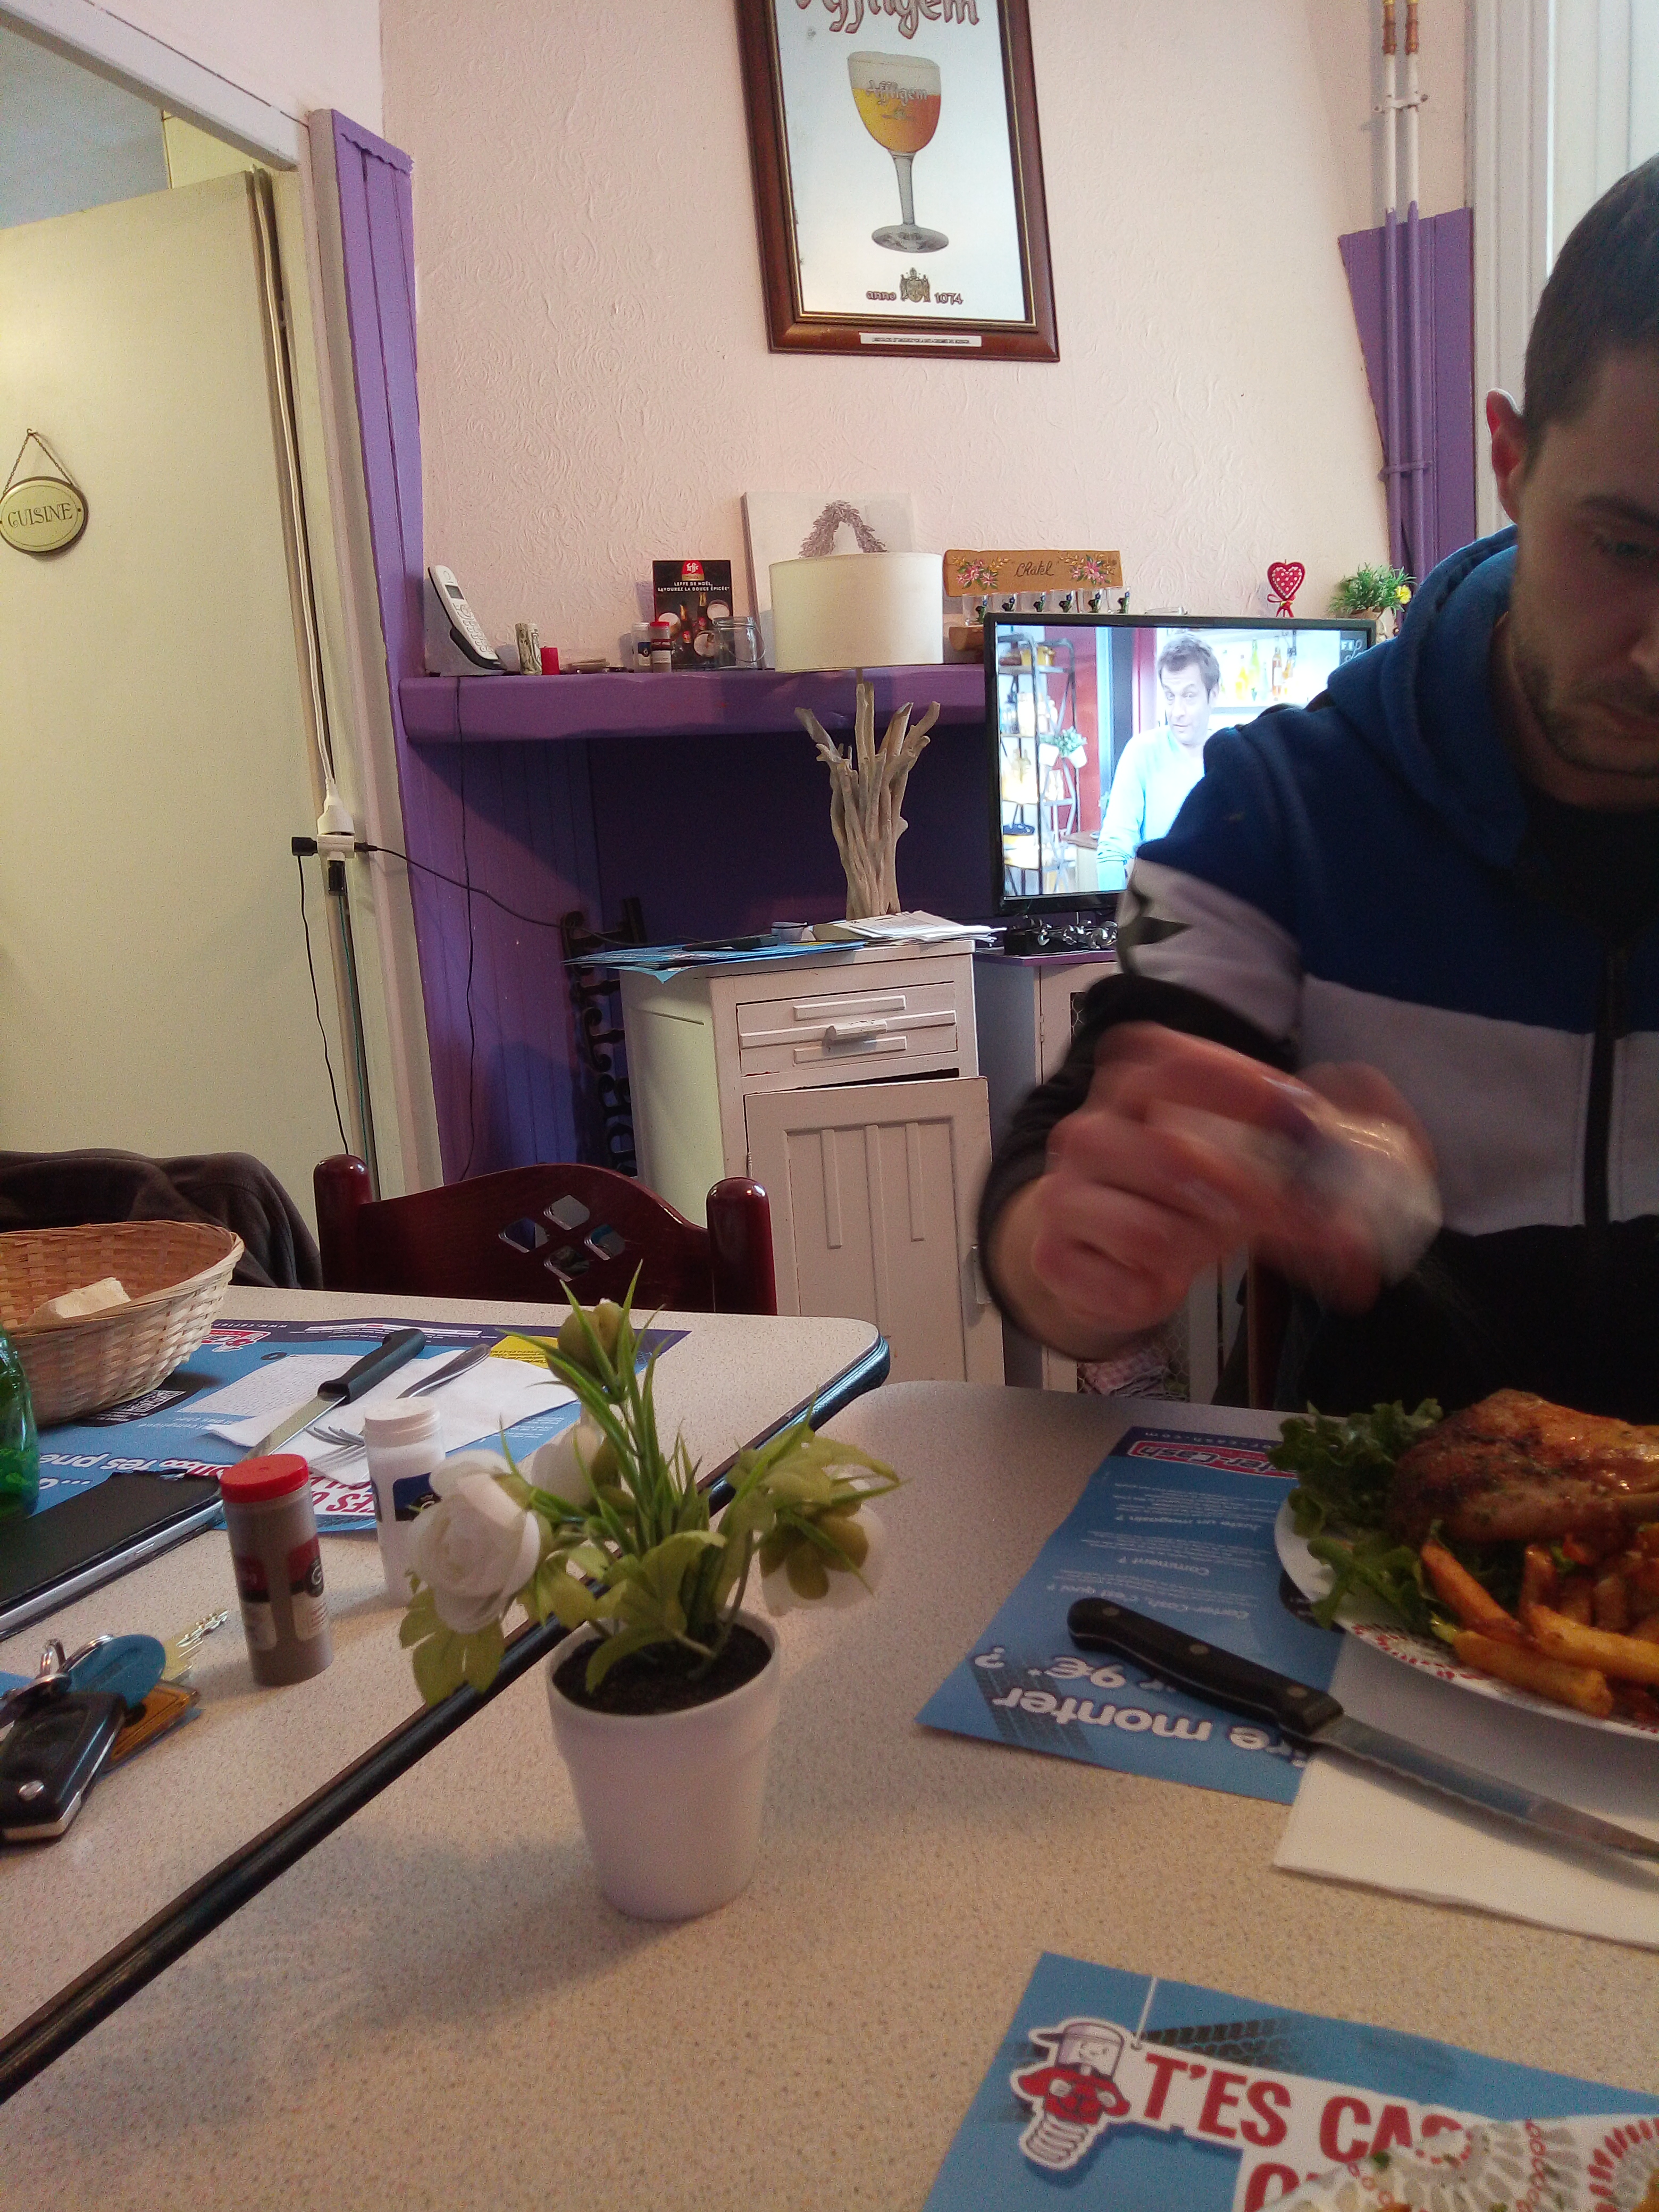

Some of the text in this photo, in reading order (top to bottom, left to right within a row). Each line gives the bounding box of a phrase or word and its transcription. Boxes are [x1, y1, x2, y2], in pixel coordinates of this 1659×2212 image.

[866, 291, 963, 305] anno 1074
[7, 502, 73, 528] CUISINE
[39, 1452, 112, 1470] pne
[992, 1687, 1213, 1742] monter
[1142, 2051, 1293, 2147] T'ES
